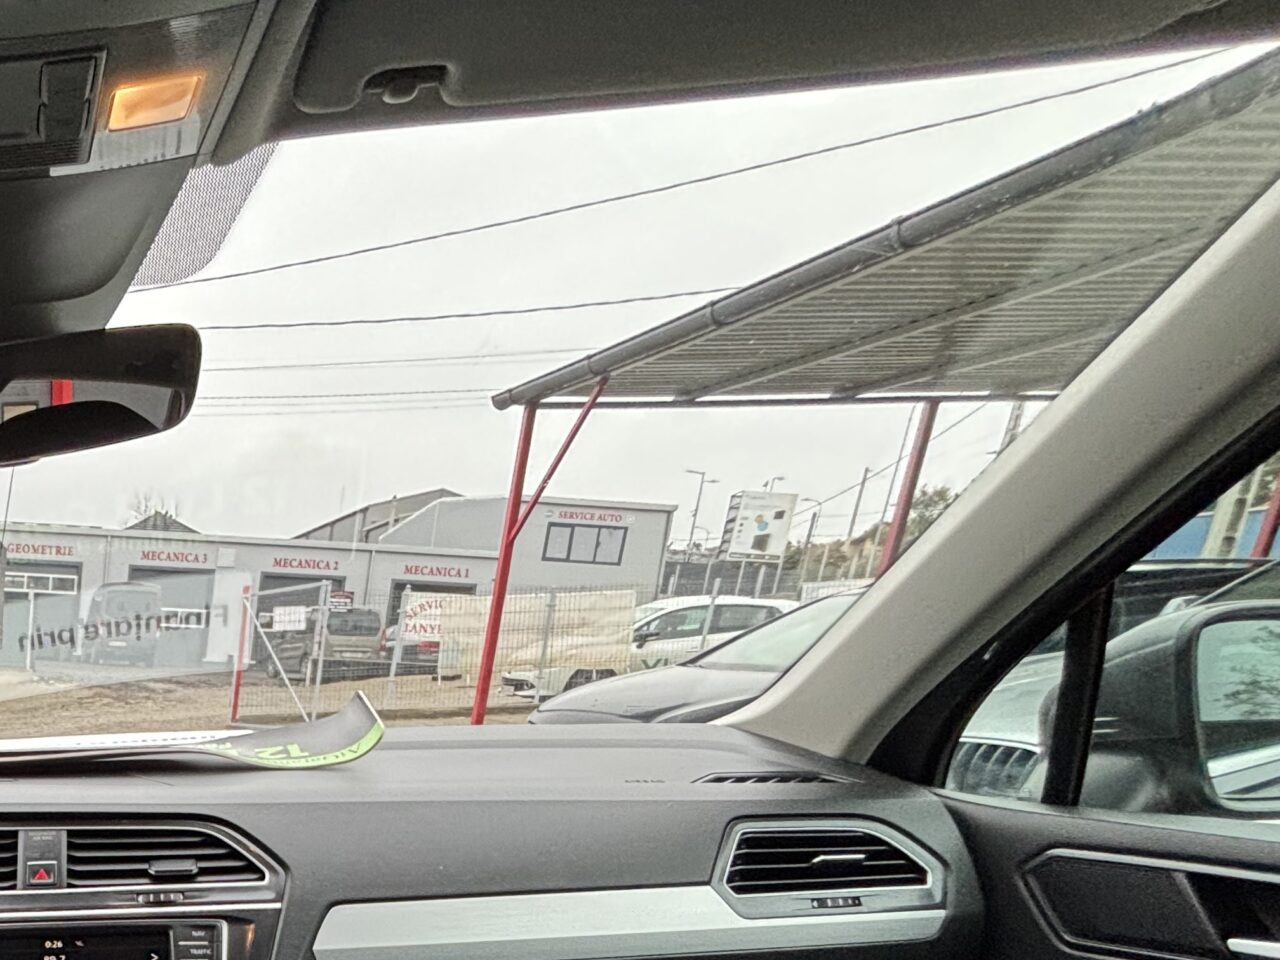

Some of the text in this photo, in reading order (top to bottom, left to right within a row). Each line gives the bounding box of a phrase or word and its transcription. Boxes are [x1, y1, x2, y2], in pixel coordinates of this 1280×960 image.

[559, 511, 622, 522] SERVICE AUTO
[6, 543, 74, 556] GEOMETRIE
[140, 551, 208, 564] MECANICA 3
[272, 557, 339, 571] MECANICA 2
[403, 565, 470, 578] MECANICA 1
